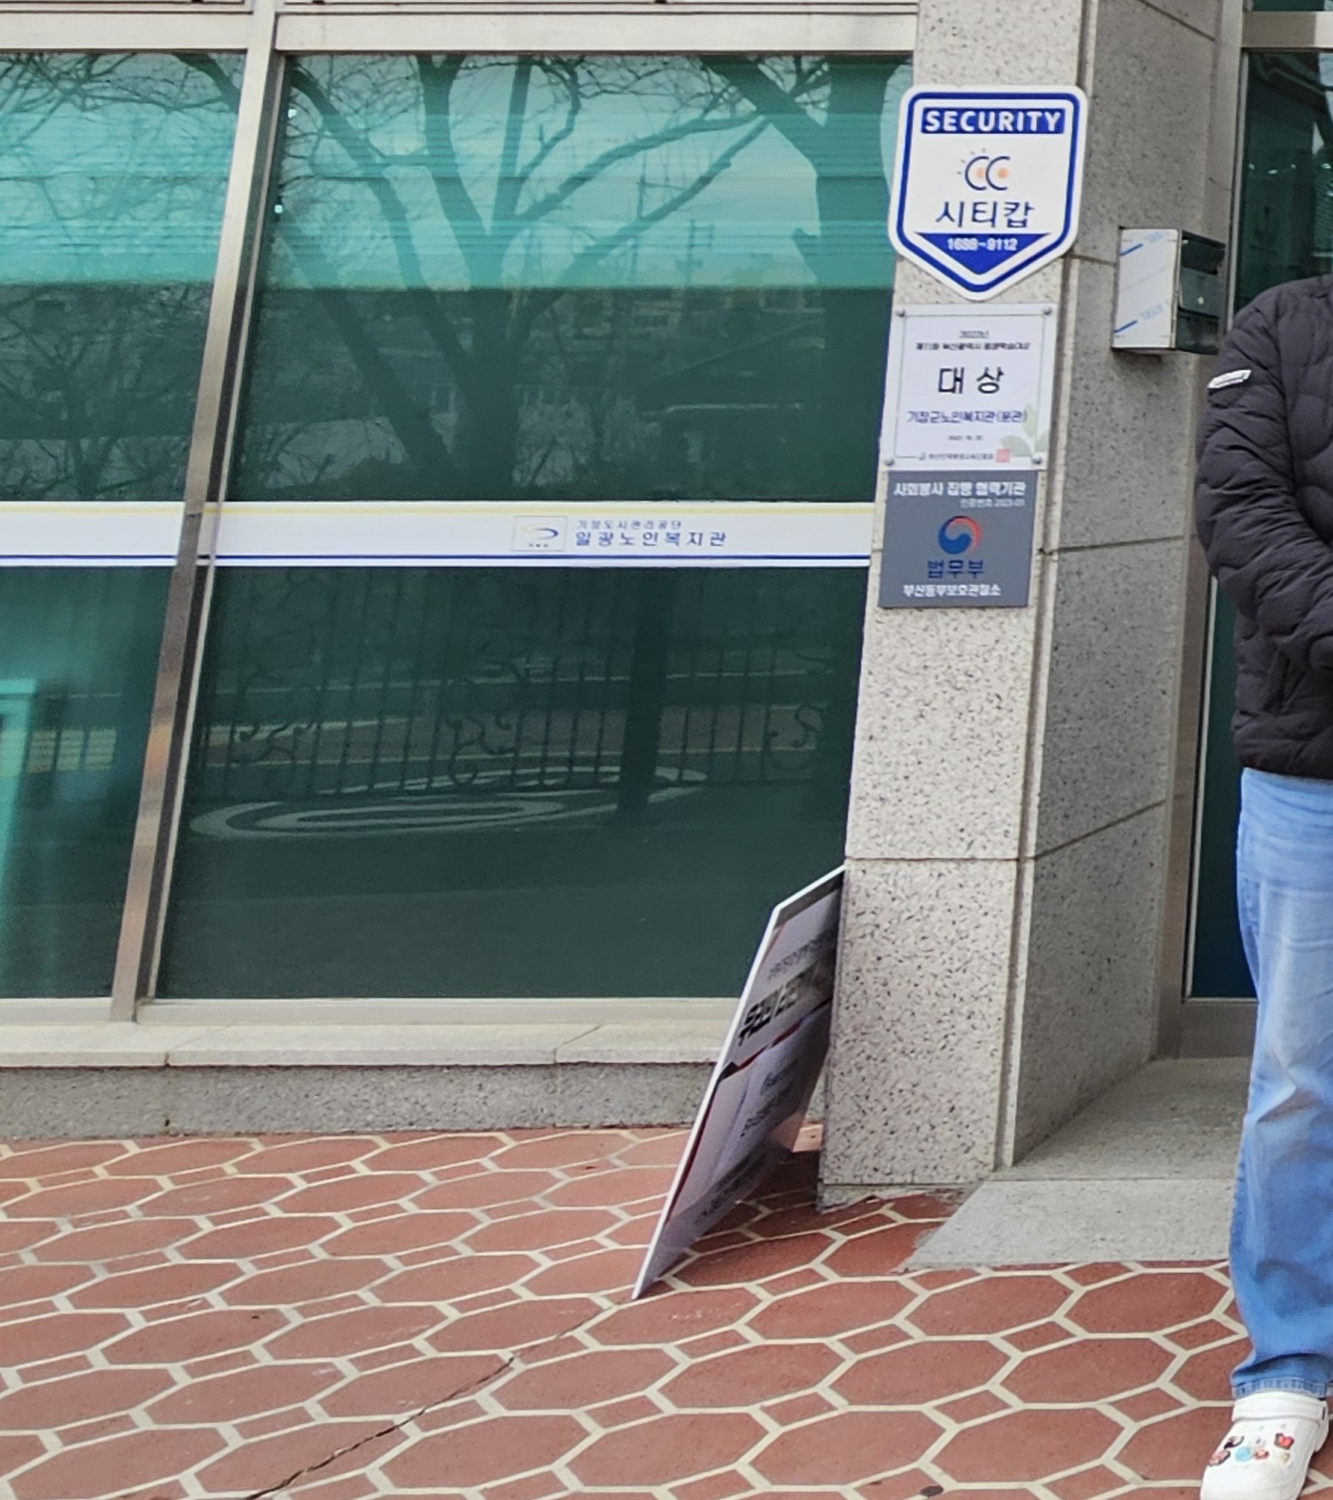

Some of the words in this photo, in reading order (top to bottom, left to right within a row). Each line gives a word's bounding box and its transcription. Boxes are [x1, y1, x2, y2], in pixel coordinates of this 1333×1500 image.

[925, 110, 1061, 132] SECURITY
[935, 201, 1034, 228] 시티캅
[575, 531, 727, 547] 일광노인복지관
[927, 560, 984, 579] 법무부
